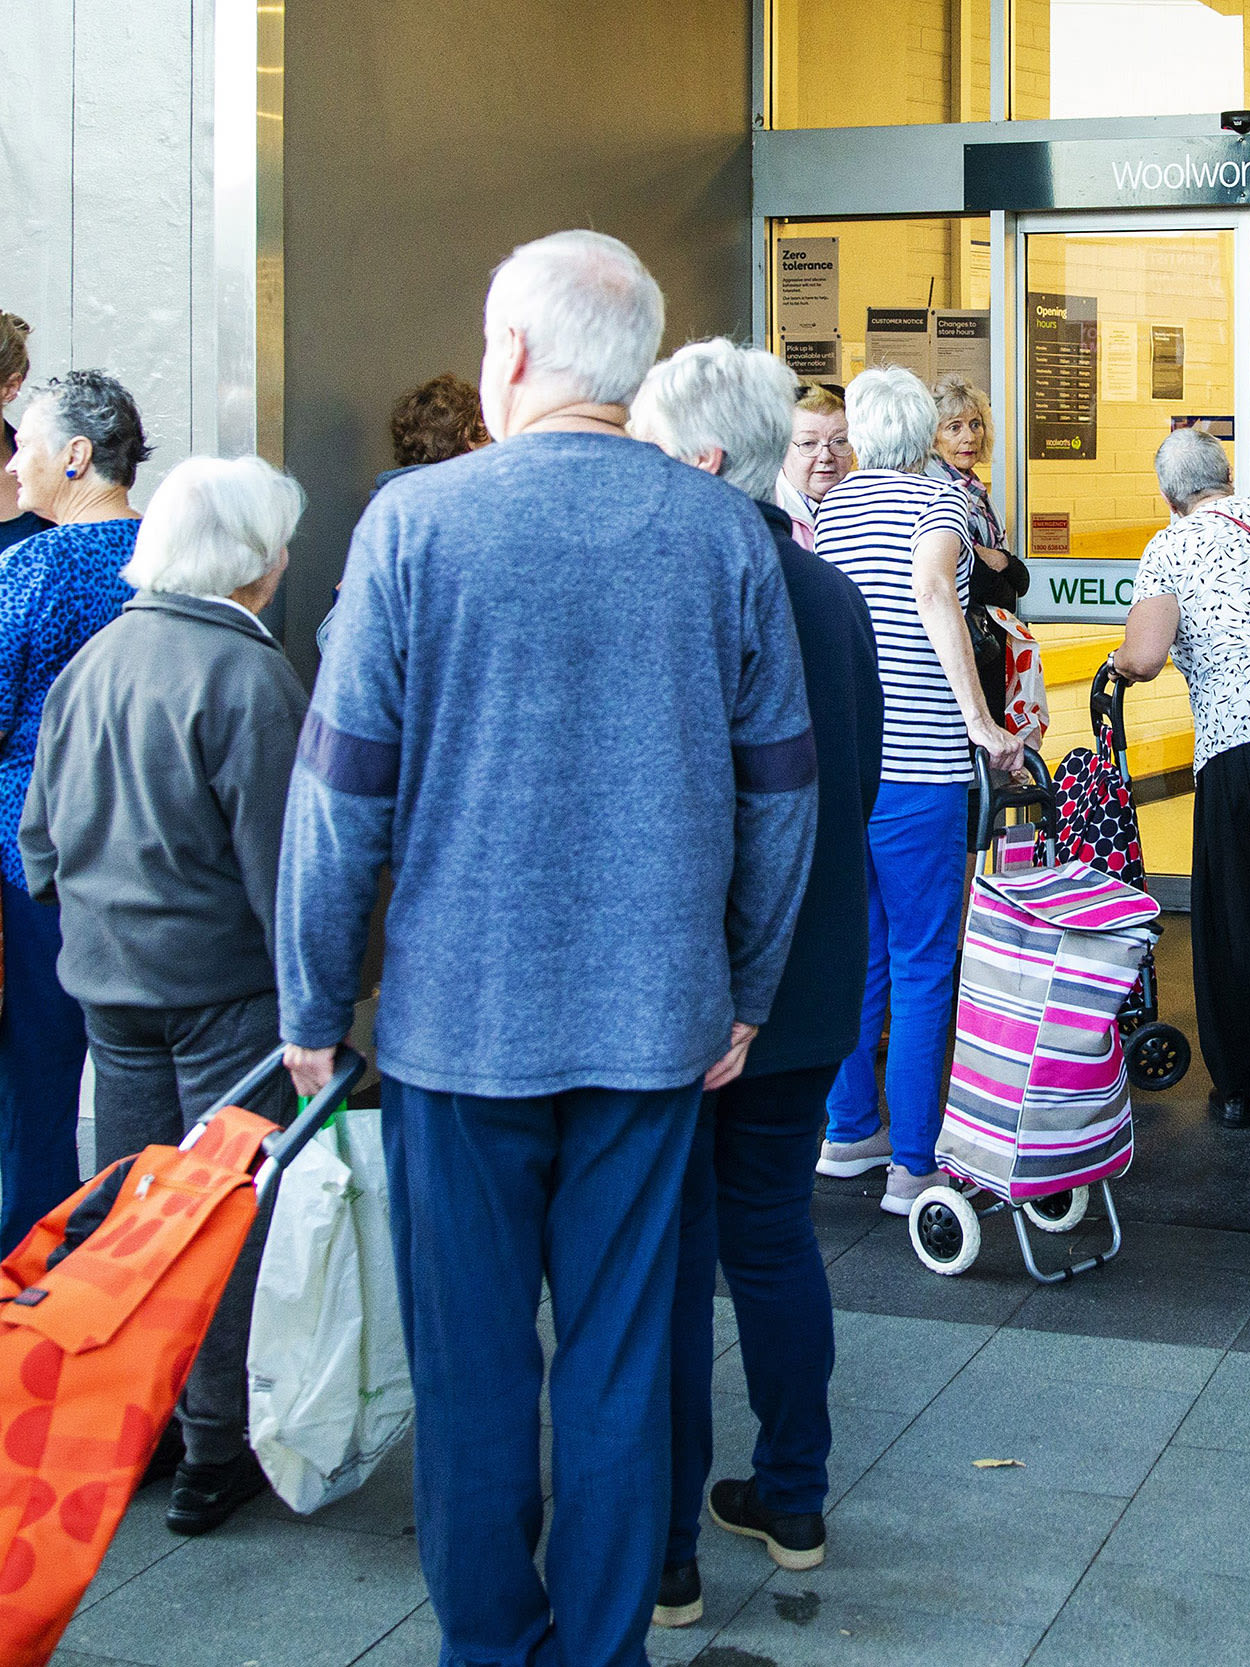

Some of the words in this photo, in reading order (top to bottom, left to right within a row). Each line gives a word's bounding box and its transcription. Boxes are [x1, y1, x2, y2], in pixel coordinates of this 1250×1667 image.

[782, 250, 807, 260] Zero
[782, 261, 833, 270] tolerance
[1036, 305, 1067, 319] Opening
[938, 320, 969, 329] Changes
[1036, 319, 1057, 329] hours
[956, 328, 975, 336] hours
[786, 344, 799, 352] Pick
[1049, 578, 1134, 606] WELC
